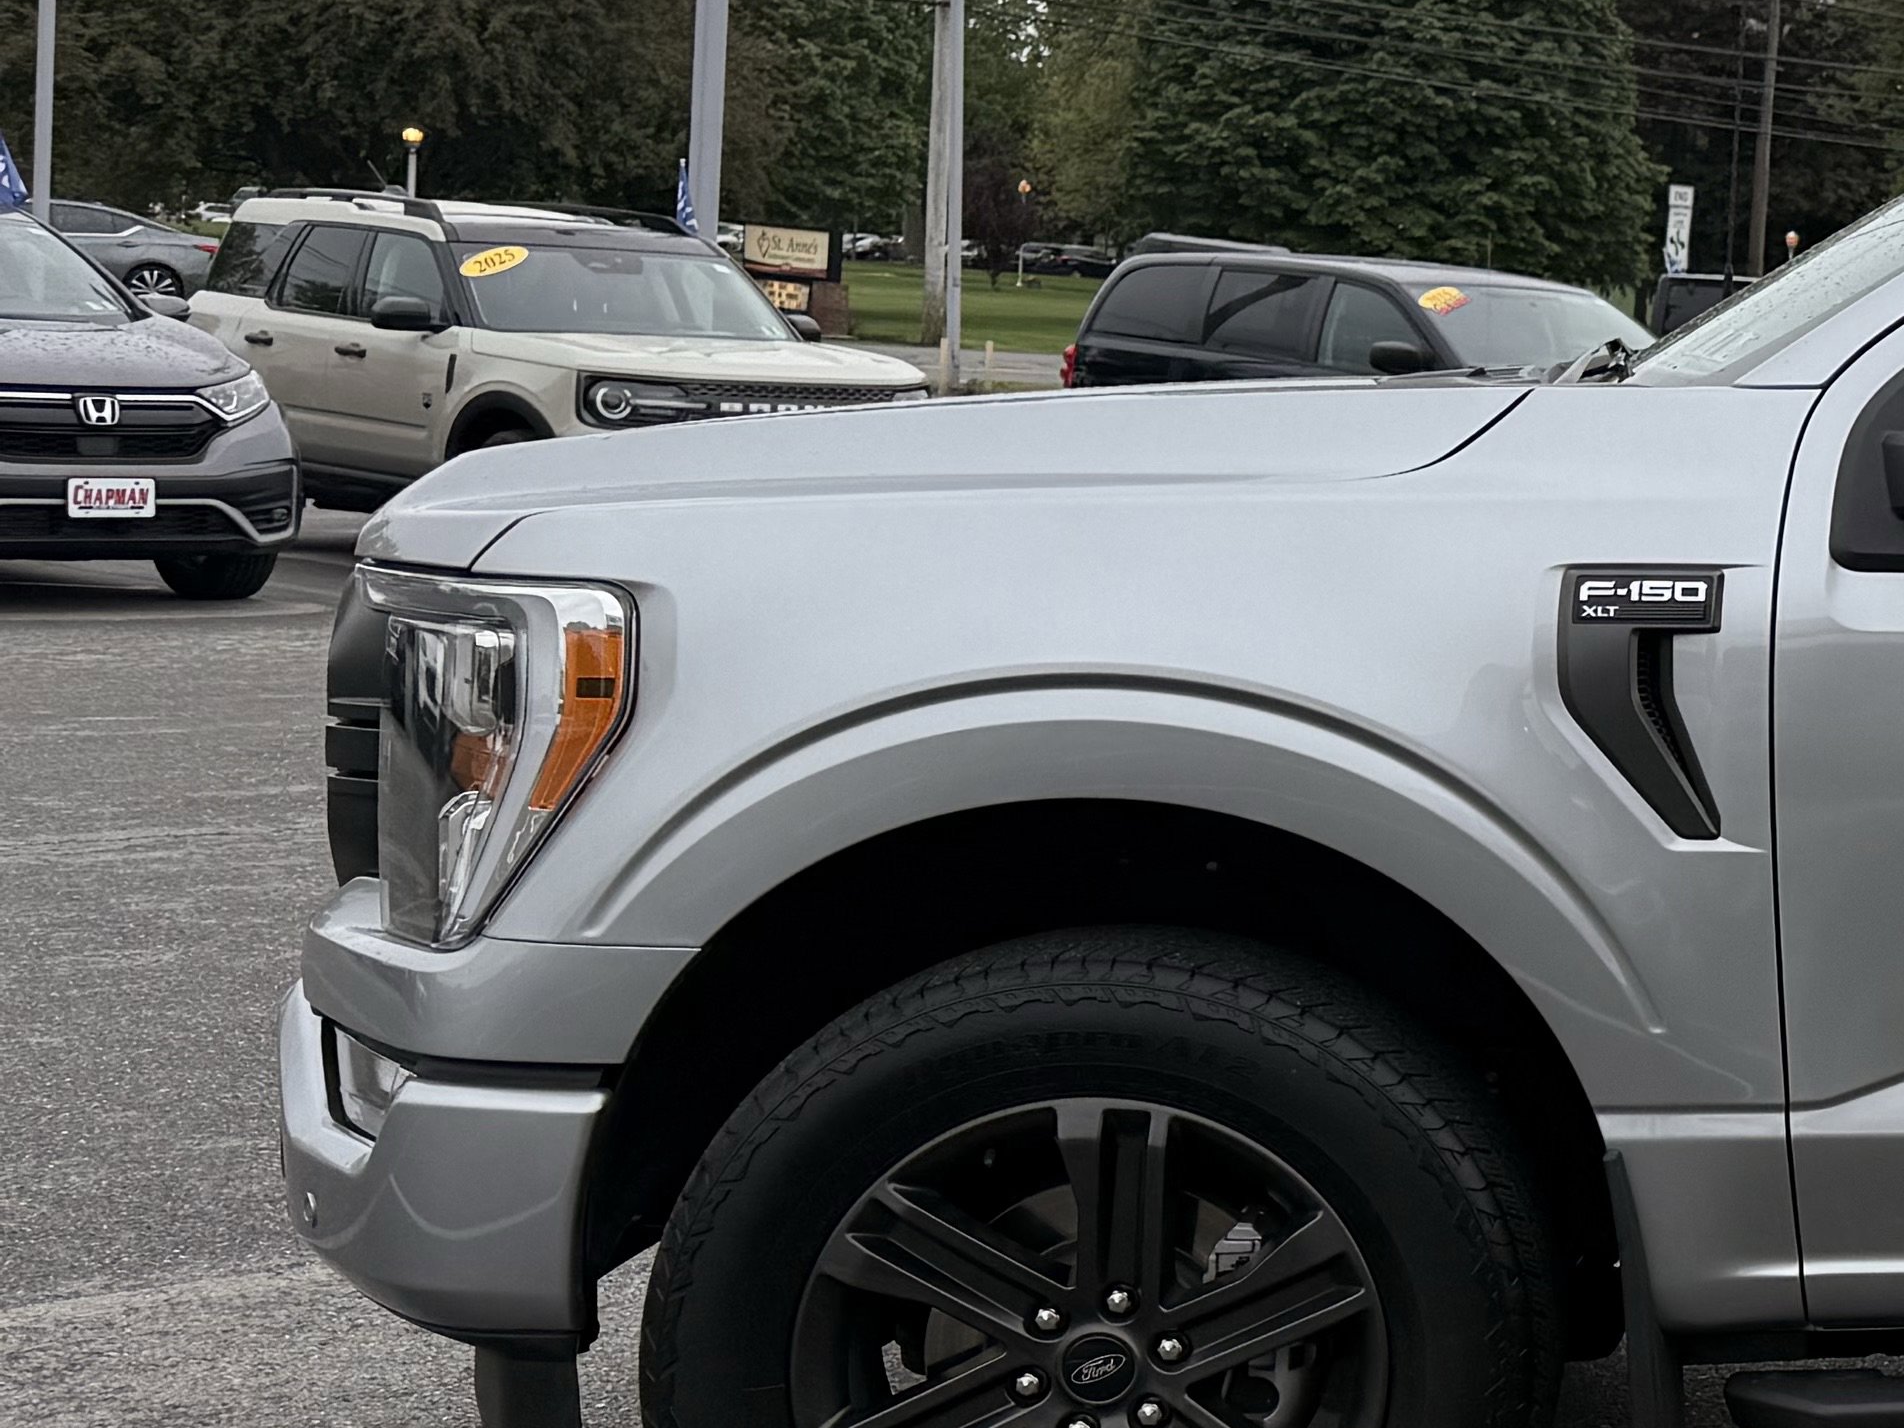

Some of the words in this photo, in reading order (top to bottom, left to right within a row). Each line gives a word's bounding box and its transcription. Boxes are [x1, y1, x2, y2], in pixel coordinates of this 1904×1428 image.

[473, 249, 516, 273] 2025
[73, 484, 150, 506] CHAPMAN
[1579, 580, 1708, 602] F-150
[1581, 605, 1620, 617] XLT
[1080, 1358, 1117, 1381] Ford
